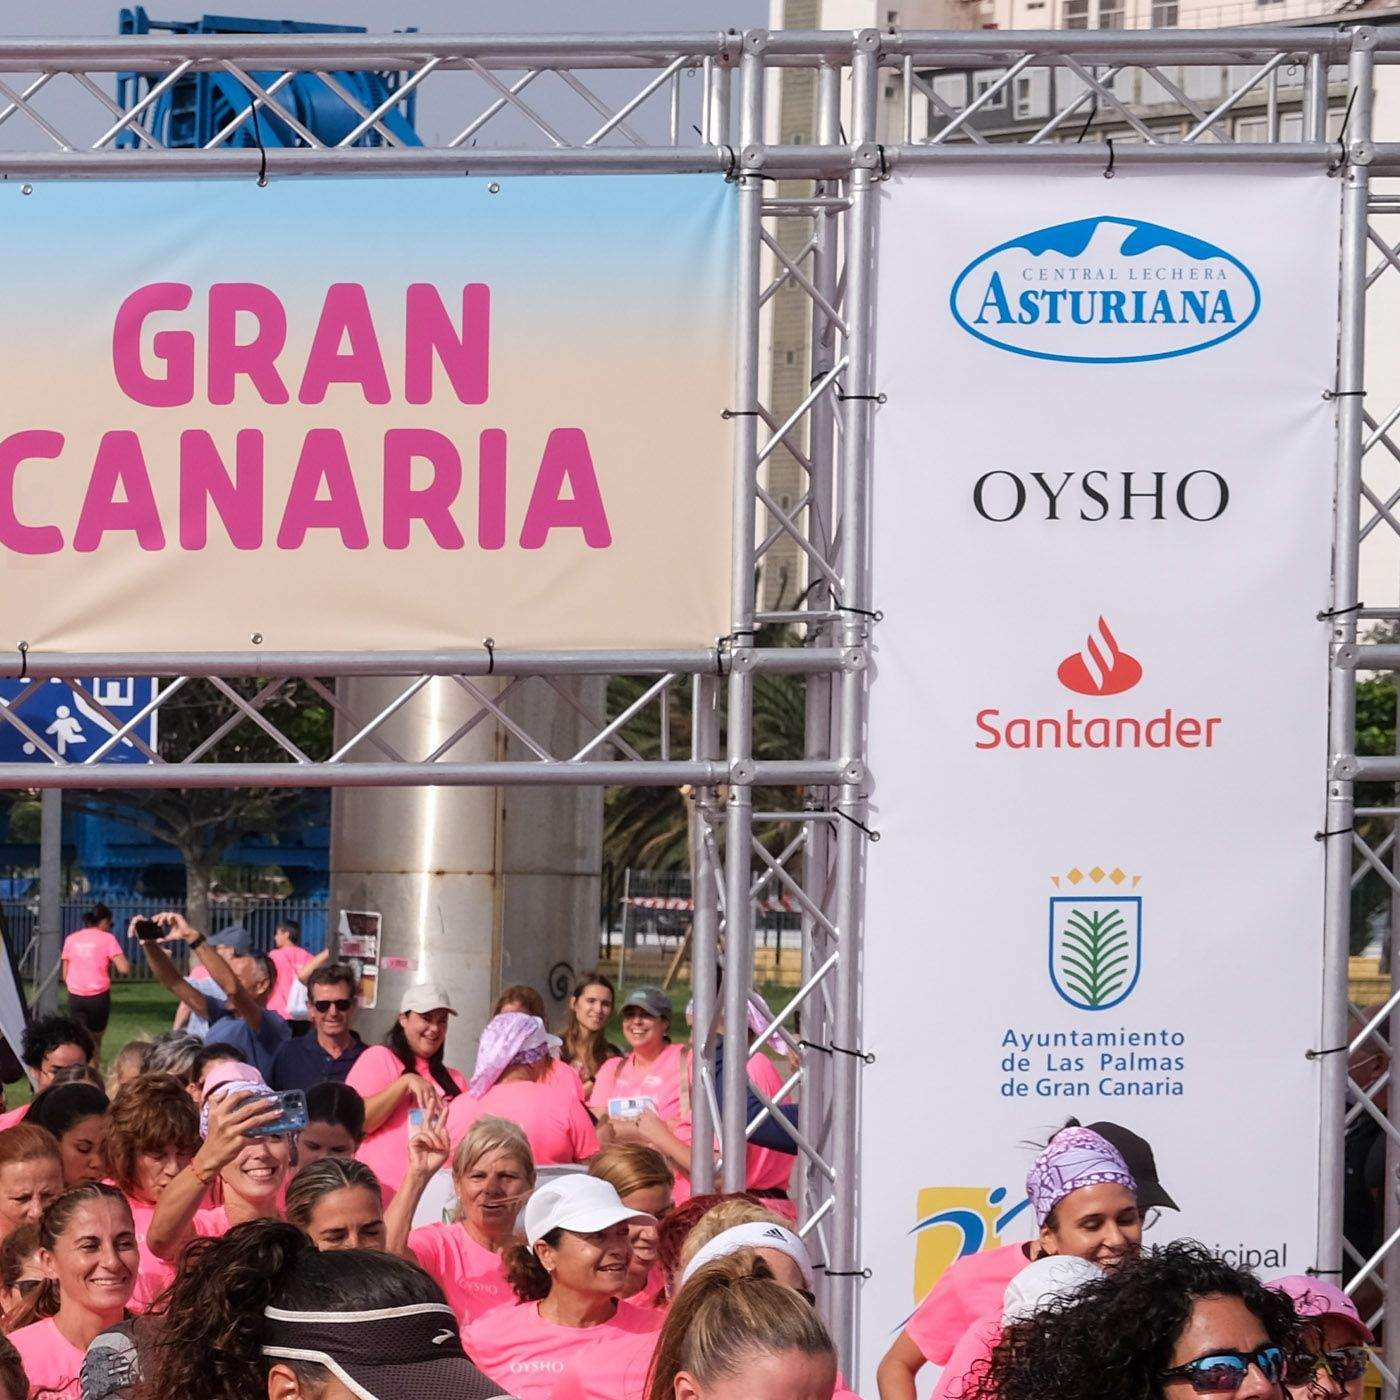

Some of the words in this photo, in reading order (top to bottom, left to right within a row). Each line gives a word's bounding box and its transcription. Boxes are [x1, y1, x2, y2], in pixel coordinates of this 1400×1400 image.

[1022, 267, 1118, 281] CENTRAL
[1129, 267, 1227, 281] LECHERA
[973, 271, 1237, 325] ASTURIANA
[112, 282, 491, 408] GRAN
[973, 470, 1229, 522] OYSHO
[975, 708, 1222, 750] Santander
[1001, 1028, 1186, 1051] Ayuntamiento
[1001, 1053, 1030, 1072] de
[1047, 1053, 1085, 1072] Las
[1100, 1053, 1185, 1072] Palmas
[1000, 1078, 1029, 1097] de
[1035, 1078, 1090, 1097] Gran
[1099, 1078, 1185, 1097] Canaria
[1214, 1243, 1287, 1272] icipal
[509, 1360, 564, 1375] OYSHO
